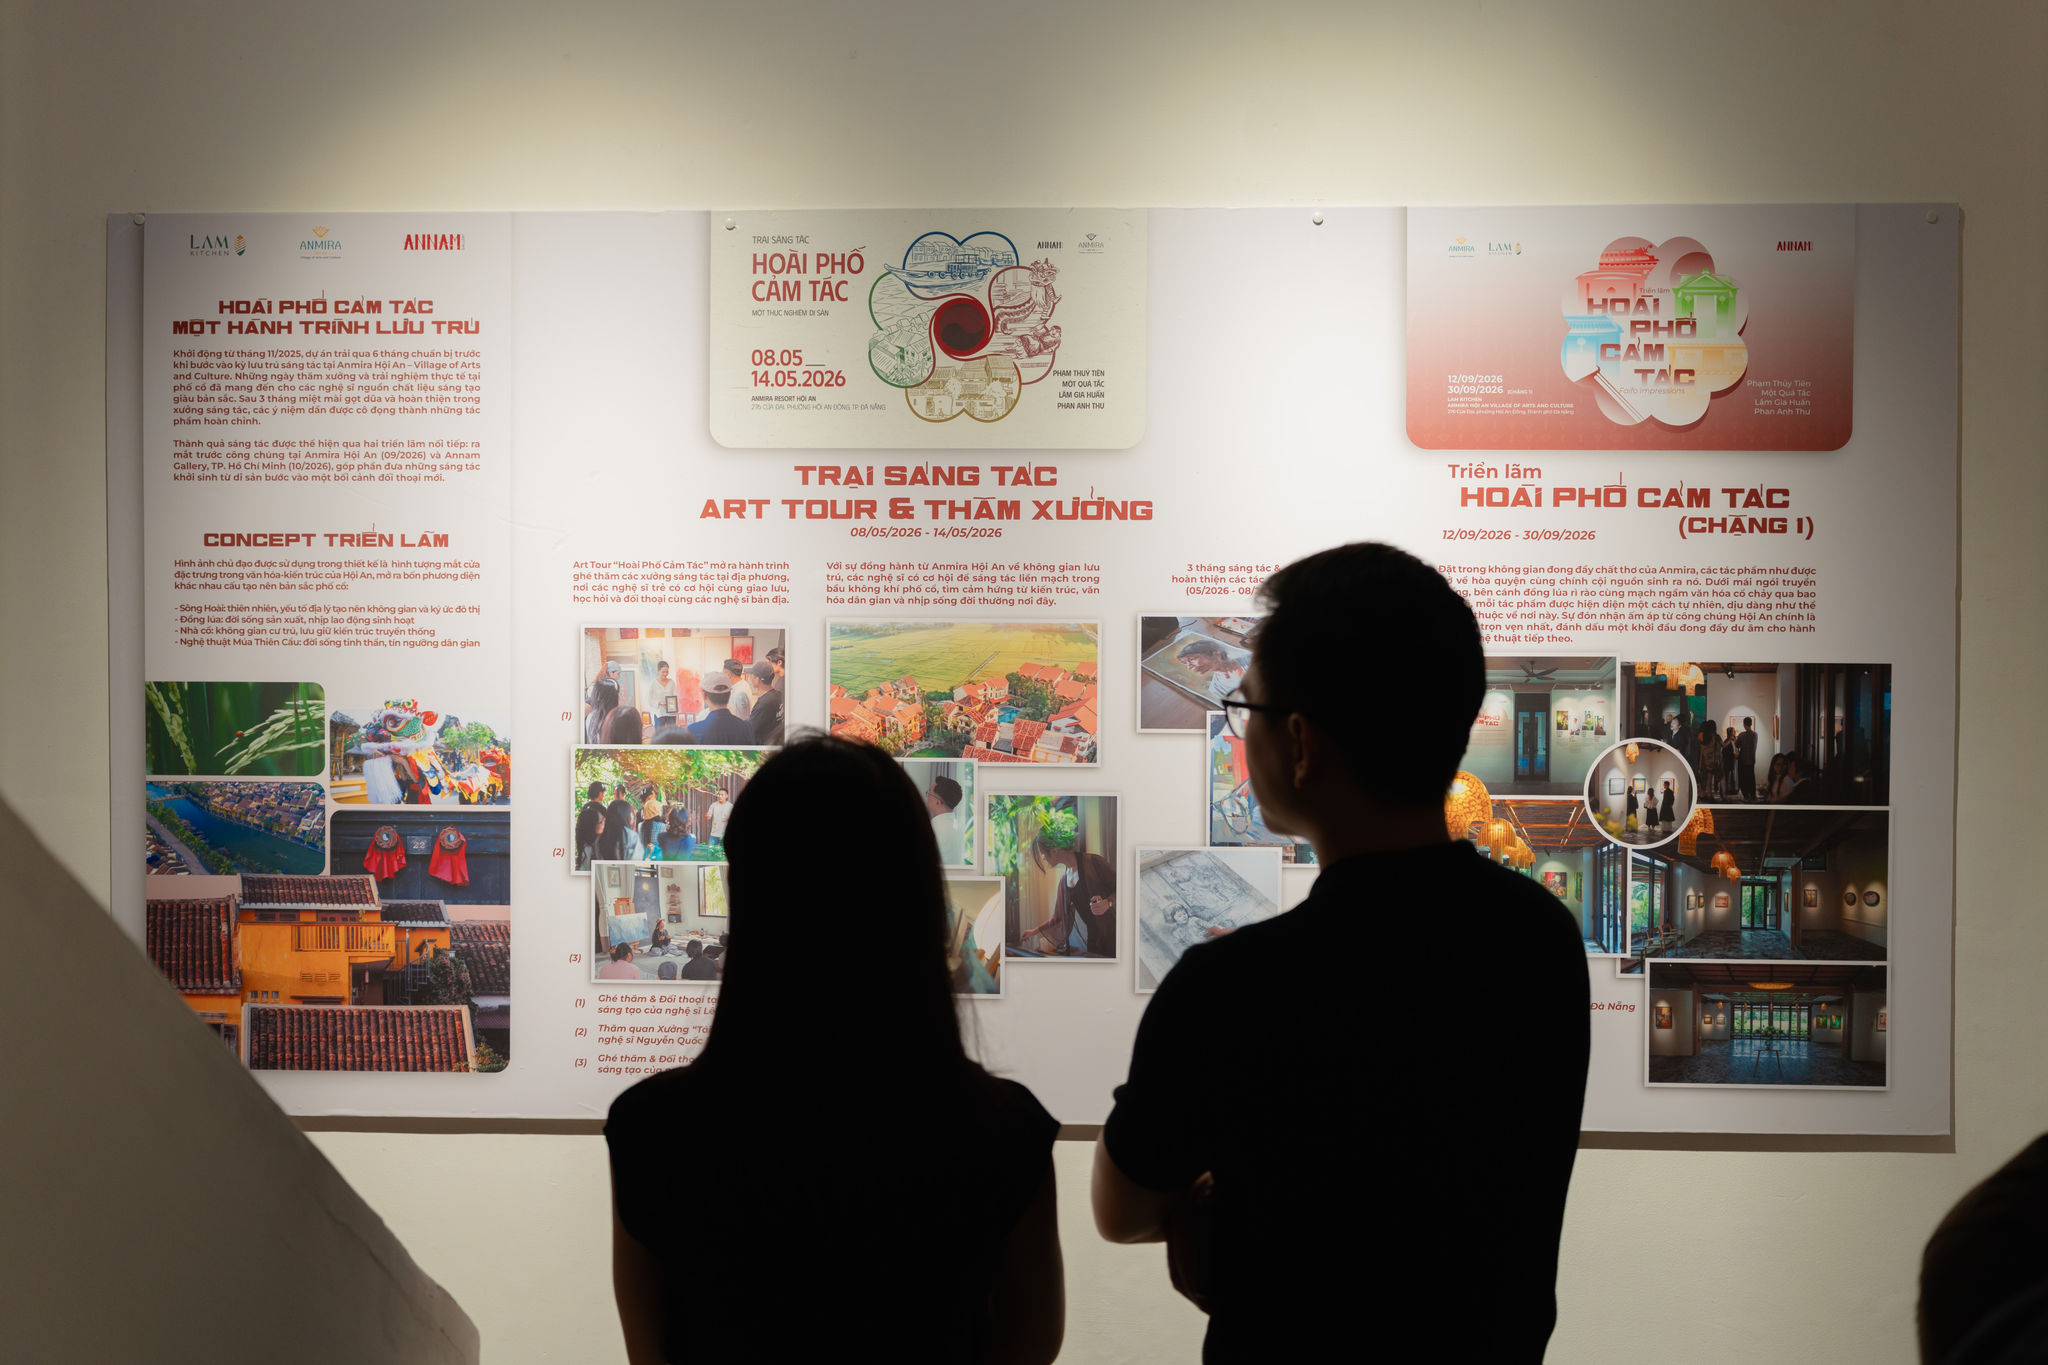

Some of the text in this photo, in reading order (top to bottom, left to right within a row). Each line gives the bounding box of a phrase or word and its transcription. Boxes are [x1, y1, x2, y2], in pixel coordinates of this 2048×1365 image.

[190, 234, 228, 249] LAM
[300, 240, 342, 250] ANMIRA
[404, 234, 460, 250] ANNAM
[1488, 242, 1512, 251] LAM
[753, 246, 866, 275] HOÀI PHỐ
[752, 275, 848, 302] CẢM TÁC
[752, 350, 802, 366] 08.05
[752, 370, 846, 387] 14.05.2026
[1448, 374, 1502, 384] 12/09/2026
[1448, 385, 1503, 394] 30/09/2026
[1448, 462, 1541, 478] Triển lãm
[700, 486, 1152, 520] ART TOUR & THĂM XƯỞNG
[204, 524, 448, 547] CONCEPT TRIỂN LÃM
[850, 526, 922, 538] 08/05/2026
[934, 526, 1002, 538] 14/05/2026
[1443, 528, 1511, 541] 12/09/2026
[1522, 529, 1596, 541] 30/09/2026
[845, 563, 857, 572] sự
[860, 562, 886, 572] đồng
[890, 562, 914, 570] hành
[918, 562, 929, 570] từ
[932, 562, 968, 570] Anmira
[972, 562, 988, 572] Hội
[1008, 562, 1020, 570] về
[1024, 563, 1055, 573] không
[1059, 562, 1080, 572] gian
[1084, 563, 1100, 571] lưu
[1196, 564, 1225, 573] tháng
[1228, 564, 1252, 573] sáng
[1256, 564, 1271, 572] tác
[1186, 586, 1229, 595] (05/2026
[1608, 1001, 1635, 1012] Nẵng
